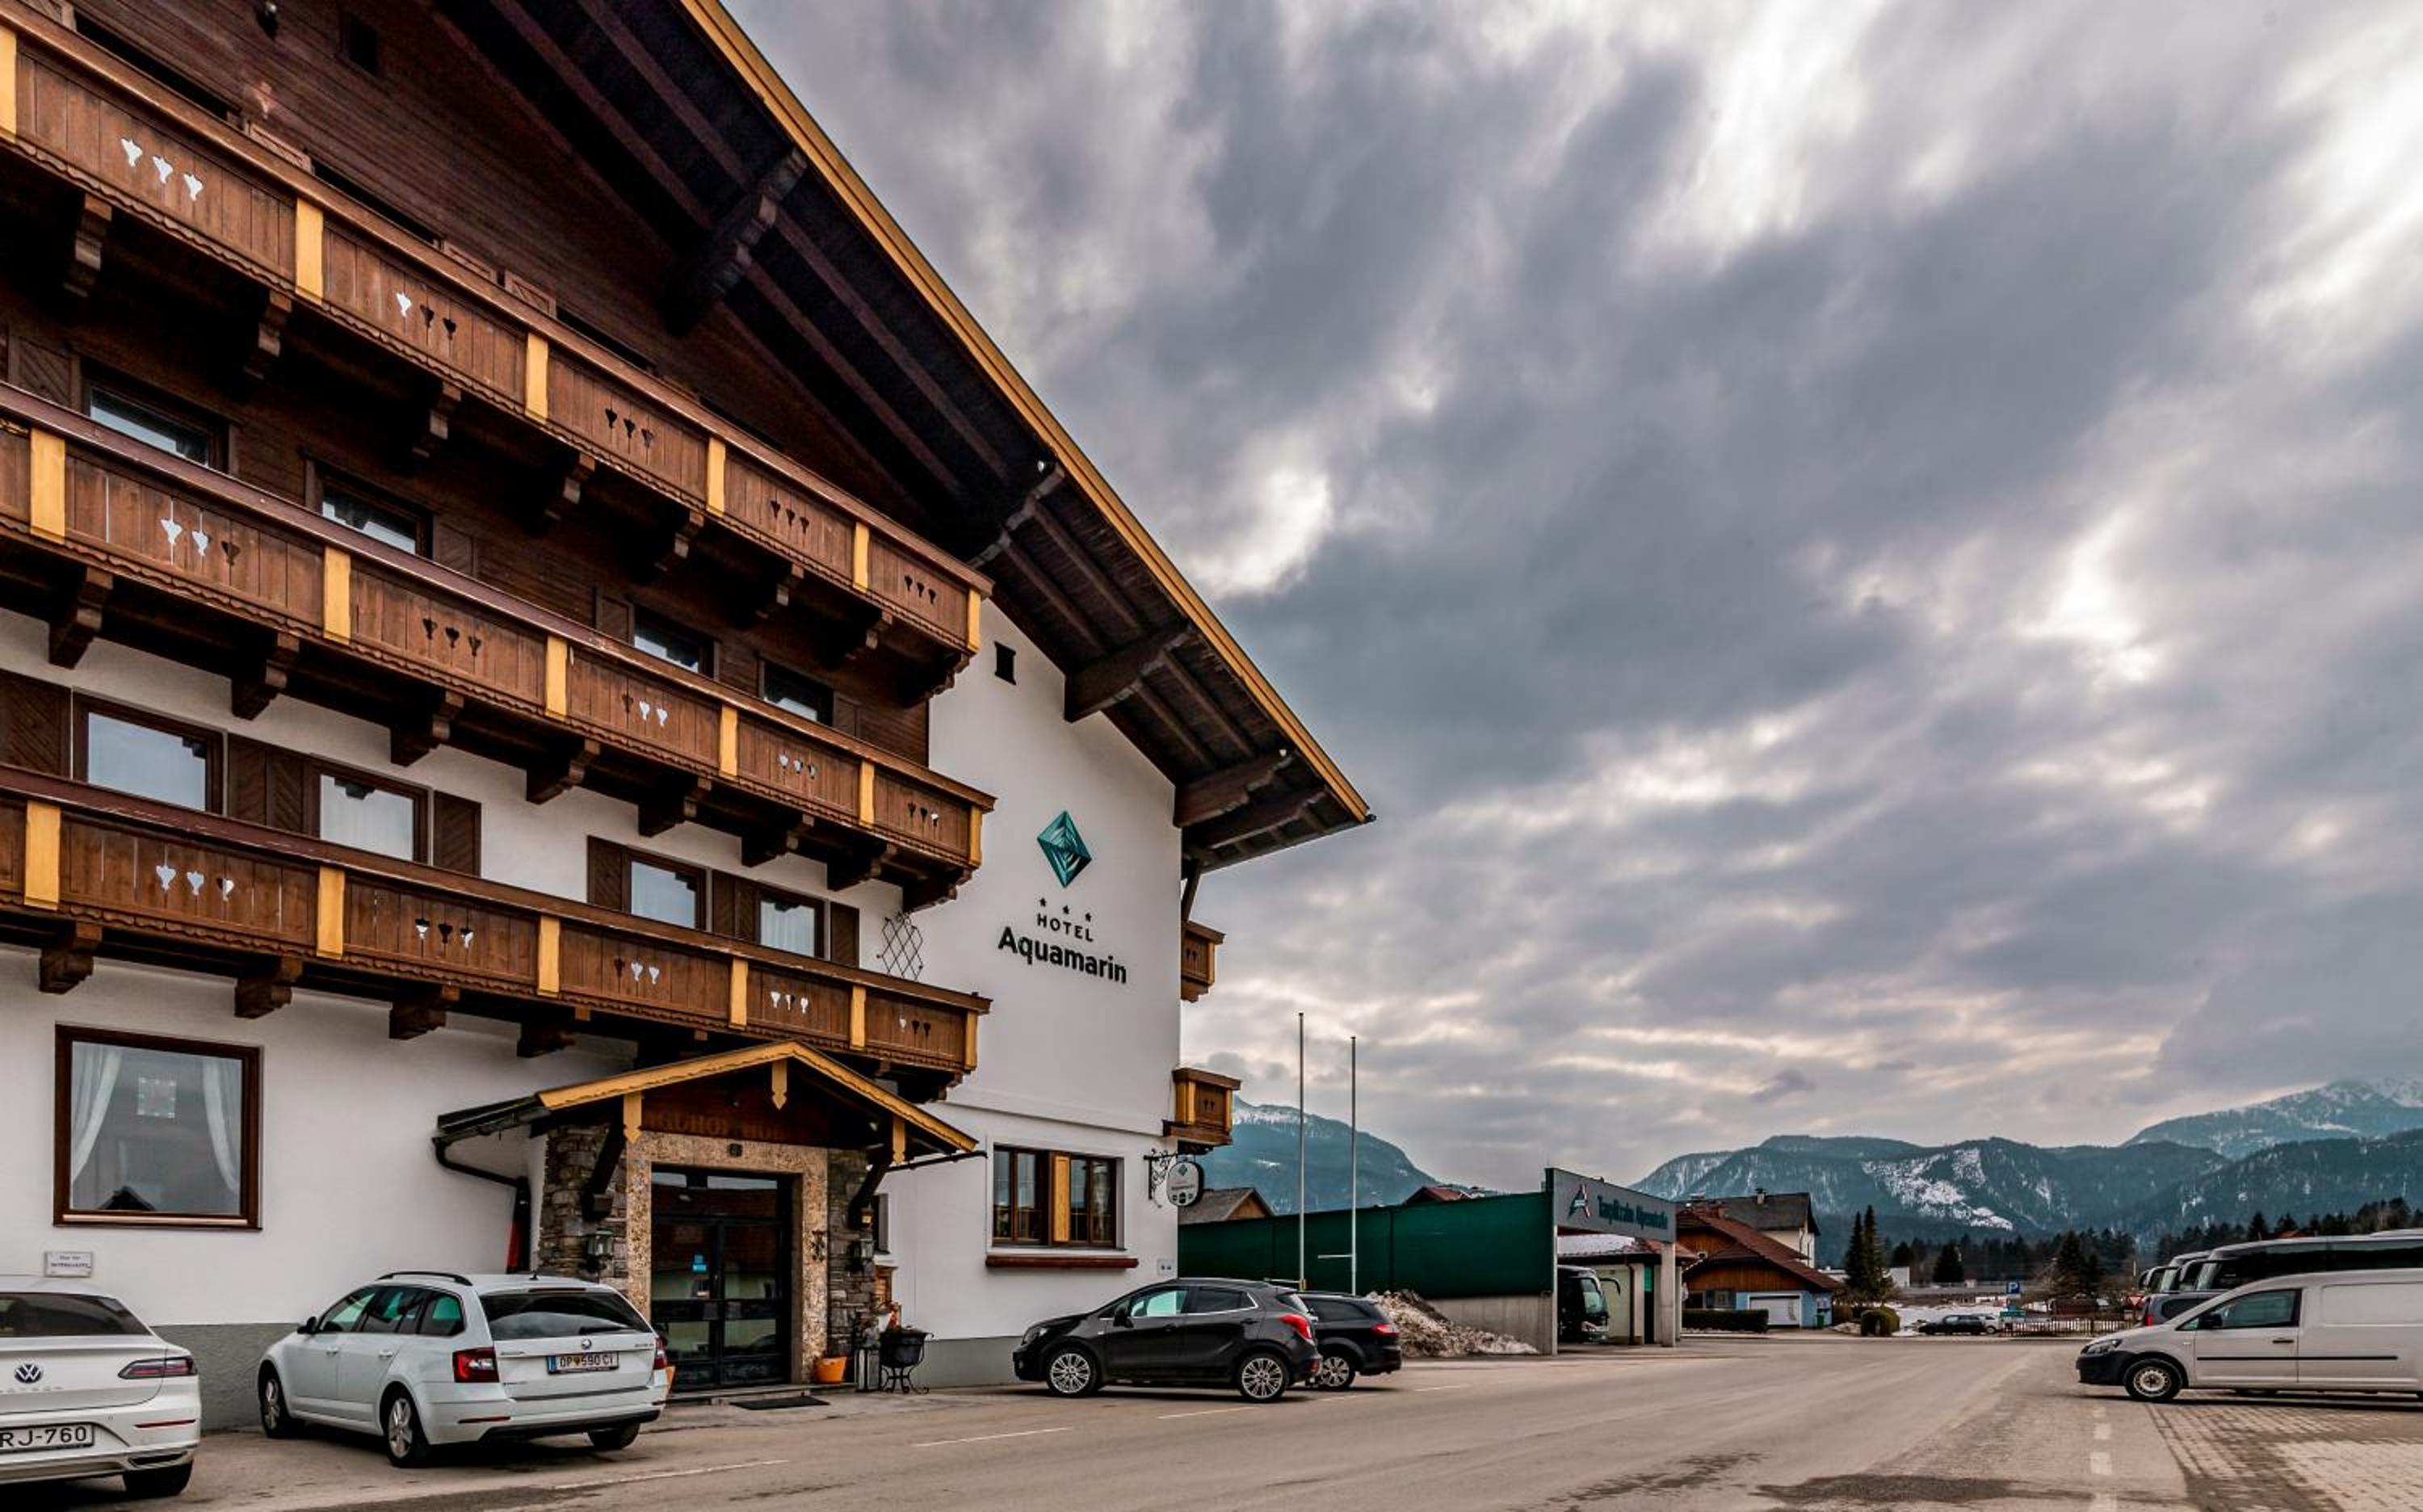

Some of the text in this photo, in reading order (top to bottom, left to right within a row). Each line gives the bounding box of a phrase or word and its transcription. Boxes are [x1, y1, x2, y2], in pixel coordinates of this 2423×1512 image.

[1036, 913, 1094, 943] HOTEL
[997, 926, 1128, 985] Aquamarin
[2008, 1282, 2018, 1293] P
